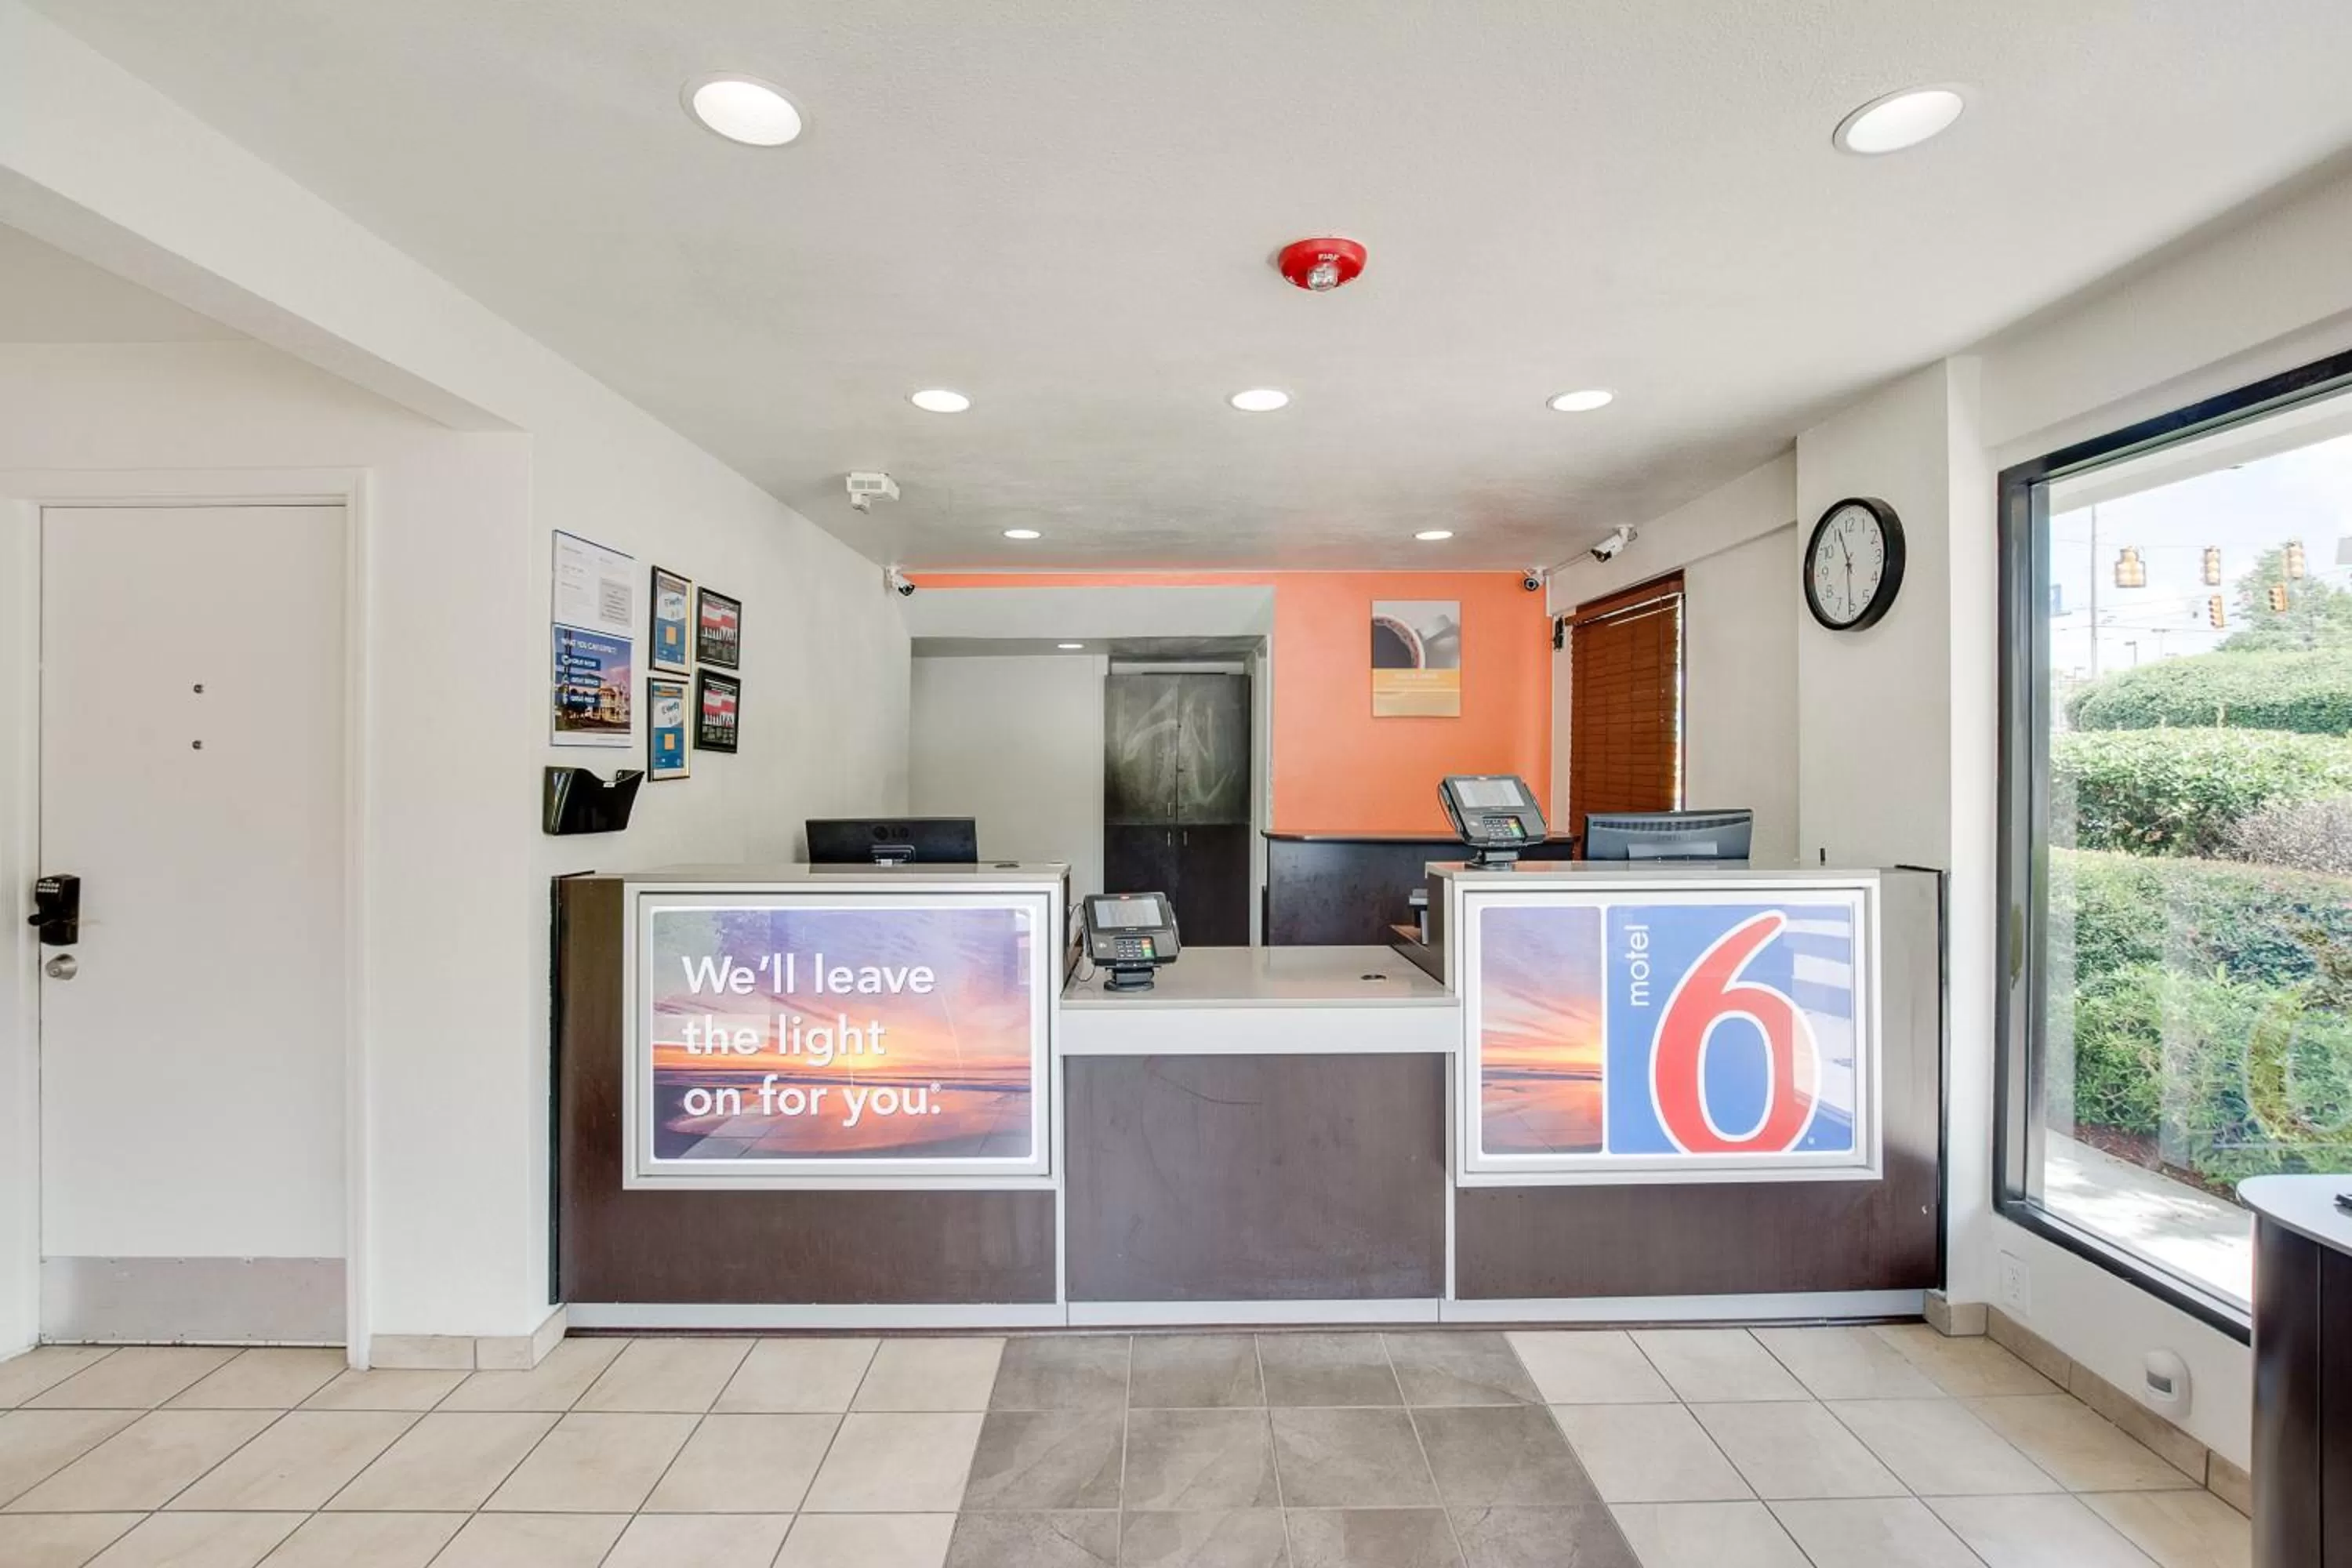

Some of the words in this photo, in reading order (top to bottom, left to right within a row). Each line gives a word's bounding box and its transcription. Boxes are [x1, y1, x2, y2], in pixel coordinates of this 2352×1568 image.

[1845, 517, 1856, 534] 12
[1871, 528, 1878, 545] 2
[1875, 548, 1882, 564] 3
[1821, 565, 1829, 581] 9
[1871, 570, 1878, 585] 4
[1835, 597, 1843, 612] 7
[1862, 589, 1870, 605] 5
[681, 953, 795, 994] We'll
[815, 953, 936, 994] leave
[1624, 924, 1650, 1006] motel
[1649, 909, 1821, 1152] 6
[682, 1013, 760, 1055] the
[778, 1013, 887, 1067] light
[683, 1086, 742, 1116] on
[758, 1073, 828, 1116] for
